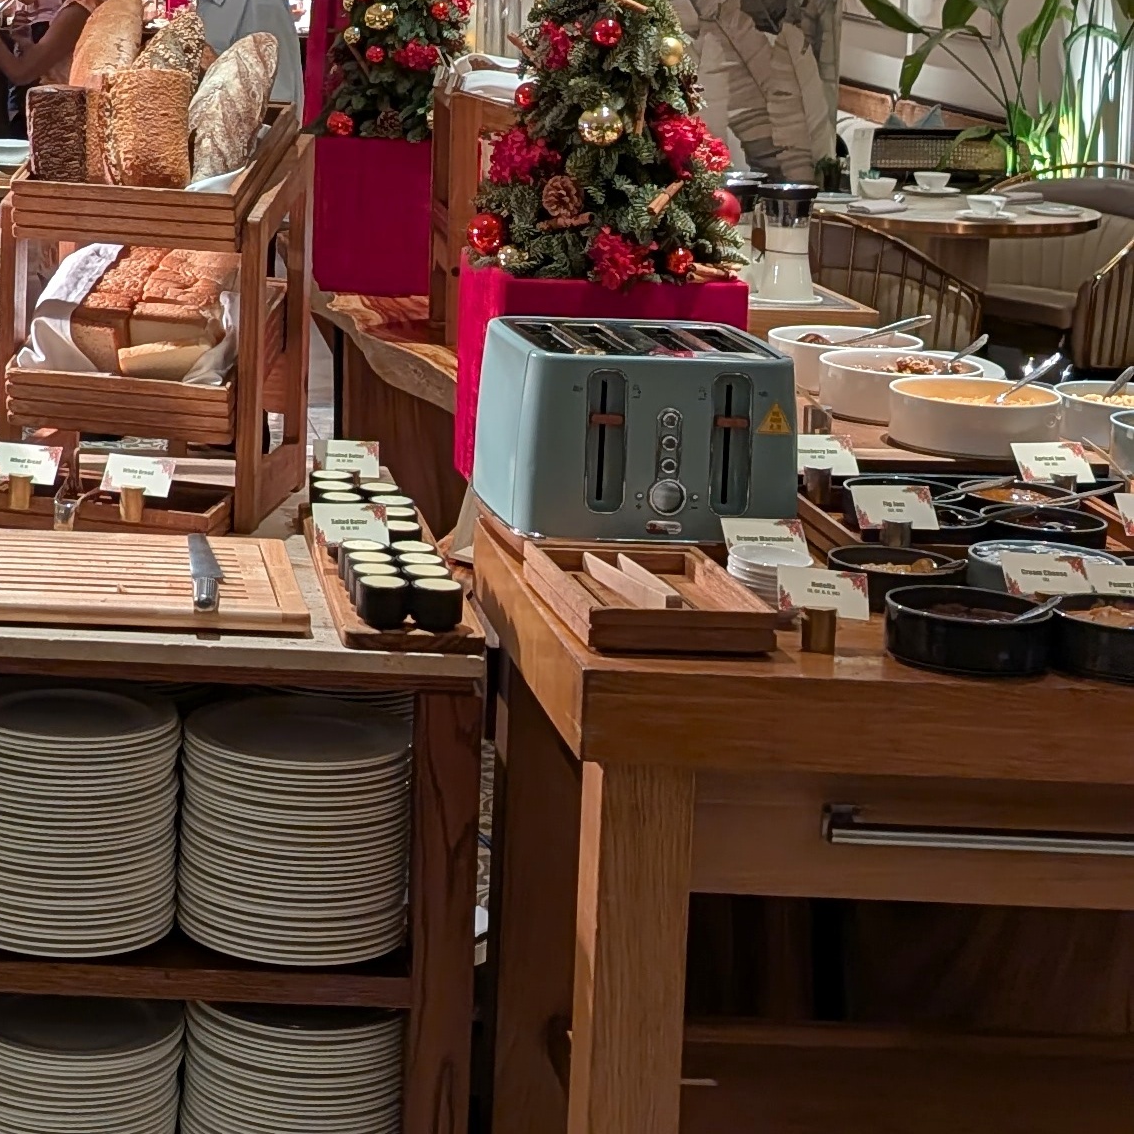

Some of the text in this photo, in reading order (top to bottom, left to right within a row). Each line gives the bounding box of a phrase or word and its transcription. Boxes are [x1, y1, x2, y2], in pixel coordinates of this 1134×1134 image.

[736, 534, 759, 542] Orange
[1020, 568, 1043, 576] Cream
[811, 581, 836, 590] Nutella
